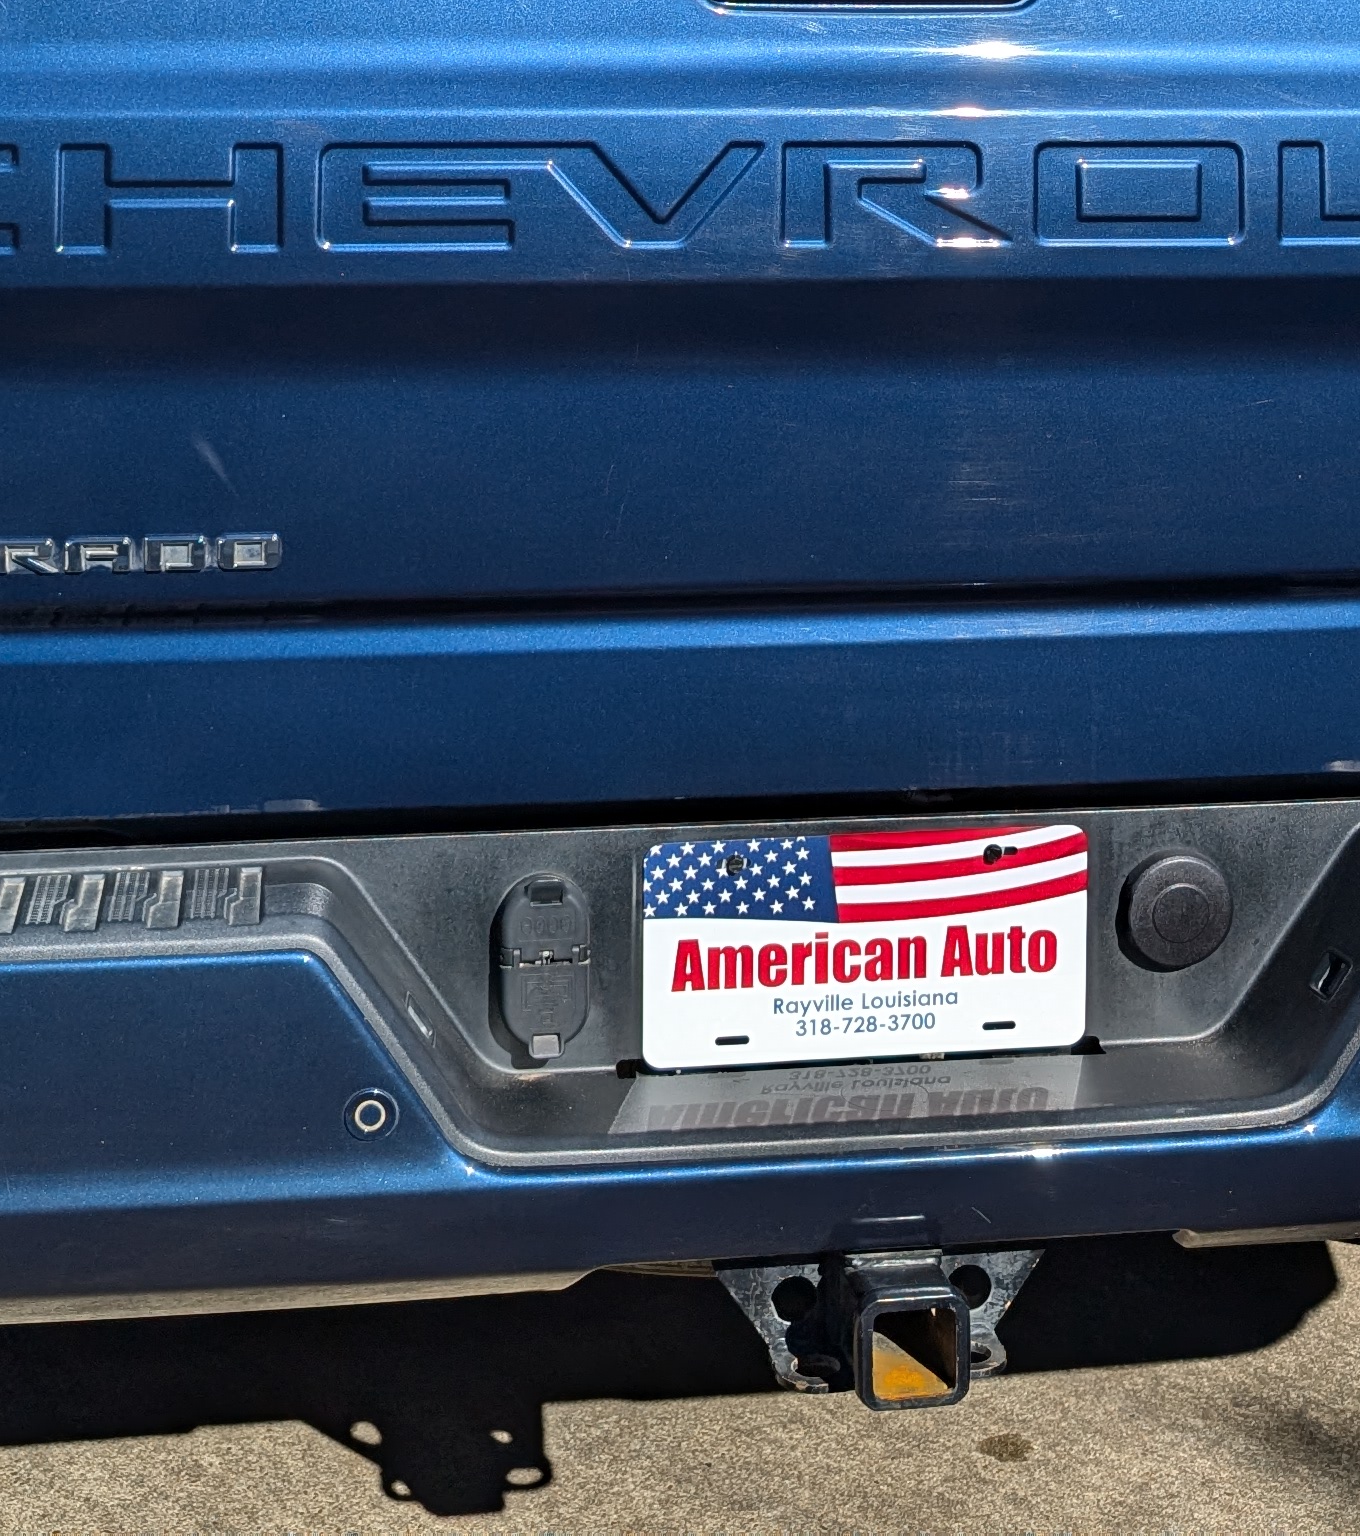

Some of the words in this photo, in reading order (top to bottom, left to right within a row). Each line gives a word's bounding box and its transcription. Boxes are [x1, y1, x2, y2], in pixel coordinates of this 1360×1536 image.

[670, 931, 928, 993] American
[940, 924, 1058, 978] Auto
[773, 994, 854, 1017] Rayville
[861, 989, 959, 1011] Louisiana
[795, 1012, 937, 1038] 318-728-3700
